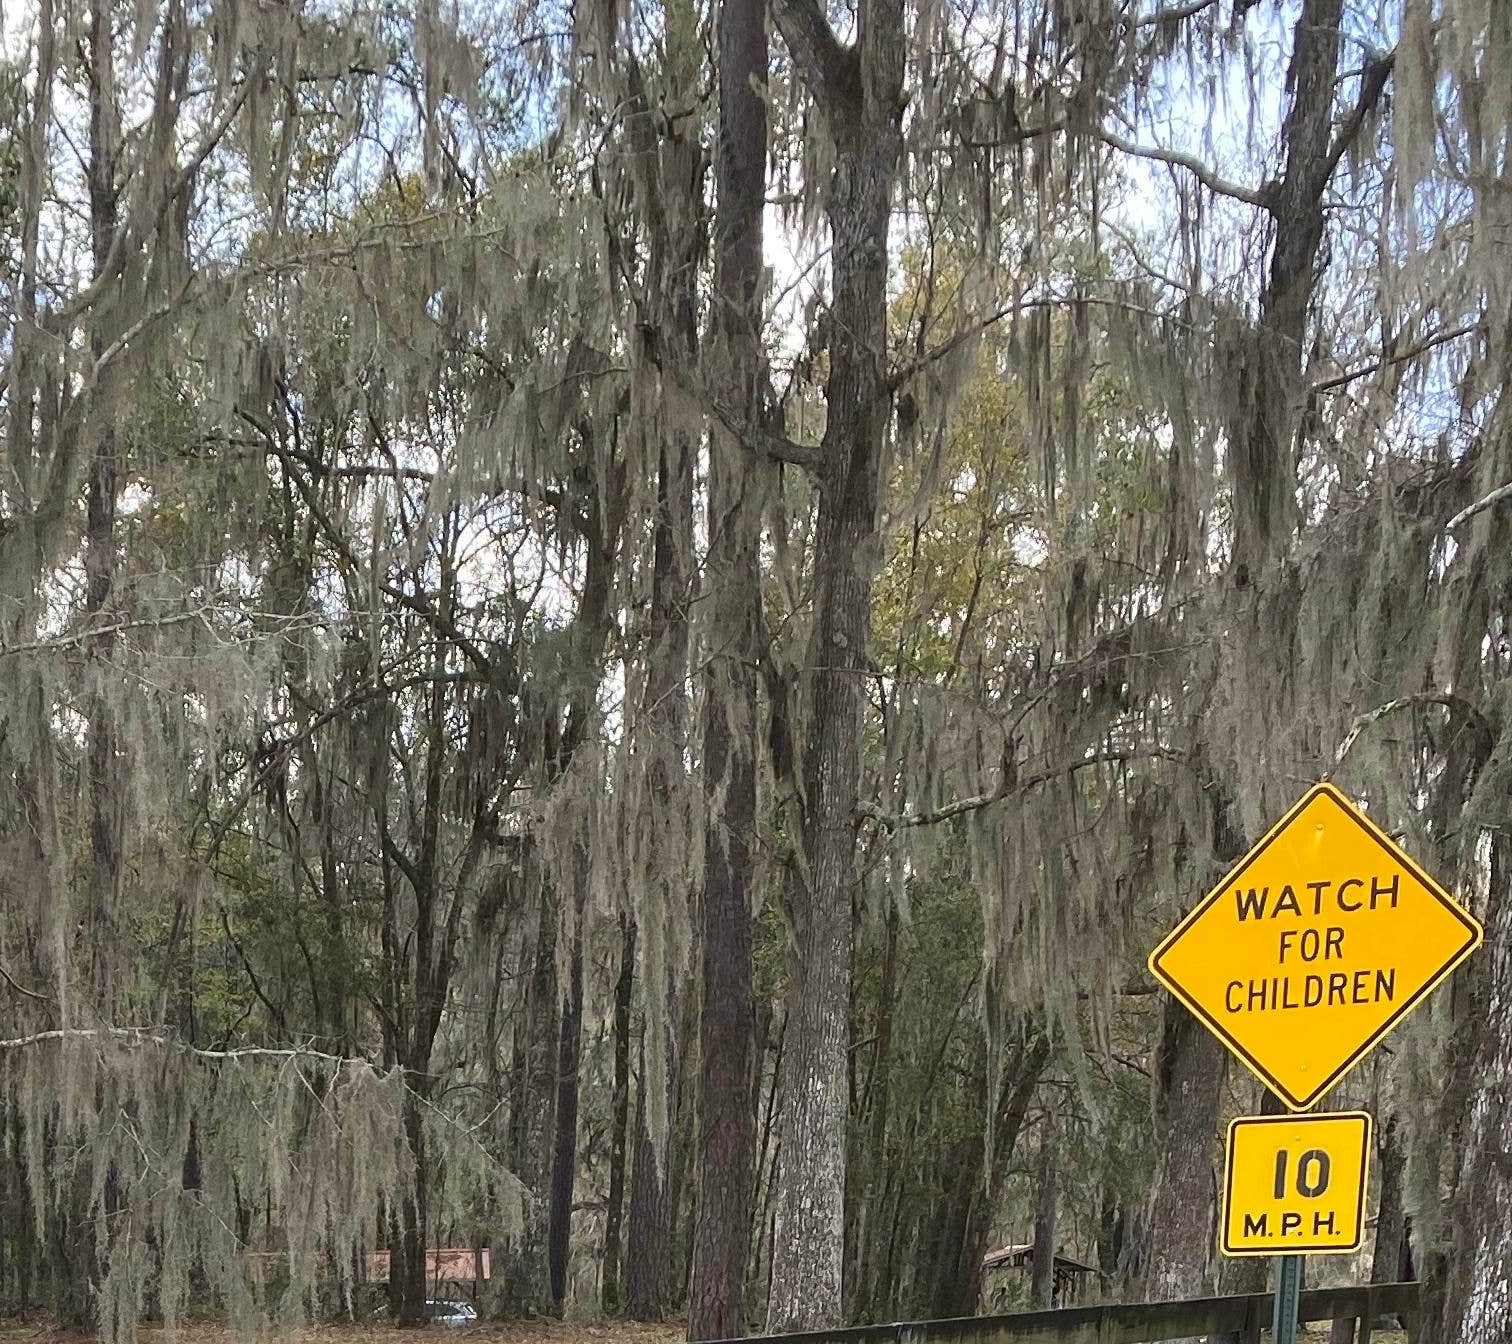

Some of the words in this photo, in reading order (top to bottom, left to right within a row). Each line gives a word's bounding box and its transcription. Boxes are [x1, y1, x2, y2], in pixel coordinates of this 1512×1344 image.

[1235, 874, 1400, 922] WATCH
[1279, 927, 1345, 964] FOR
[1225, 968, 1396, 1013] CHILDREN
[1274, 1149, 1330, 1199] 10
[1243, 1211, 1341, 1237] M.P.H.
